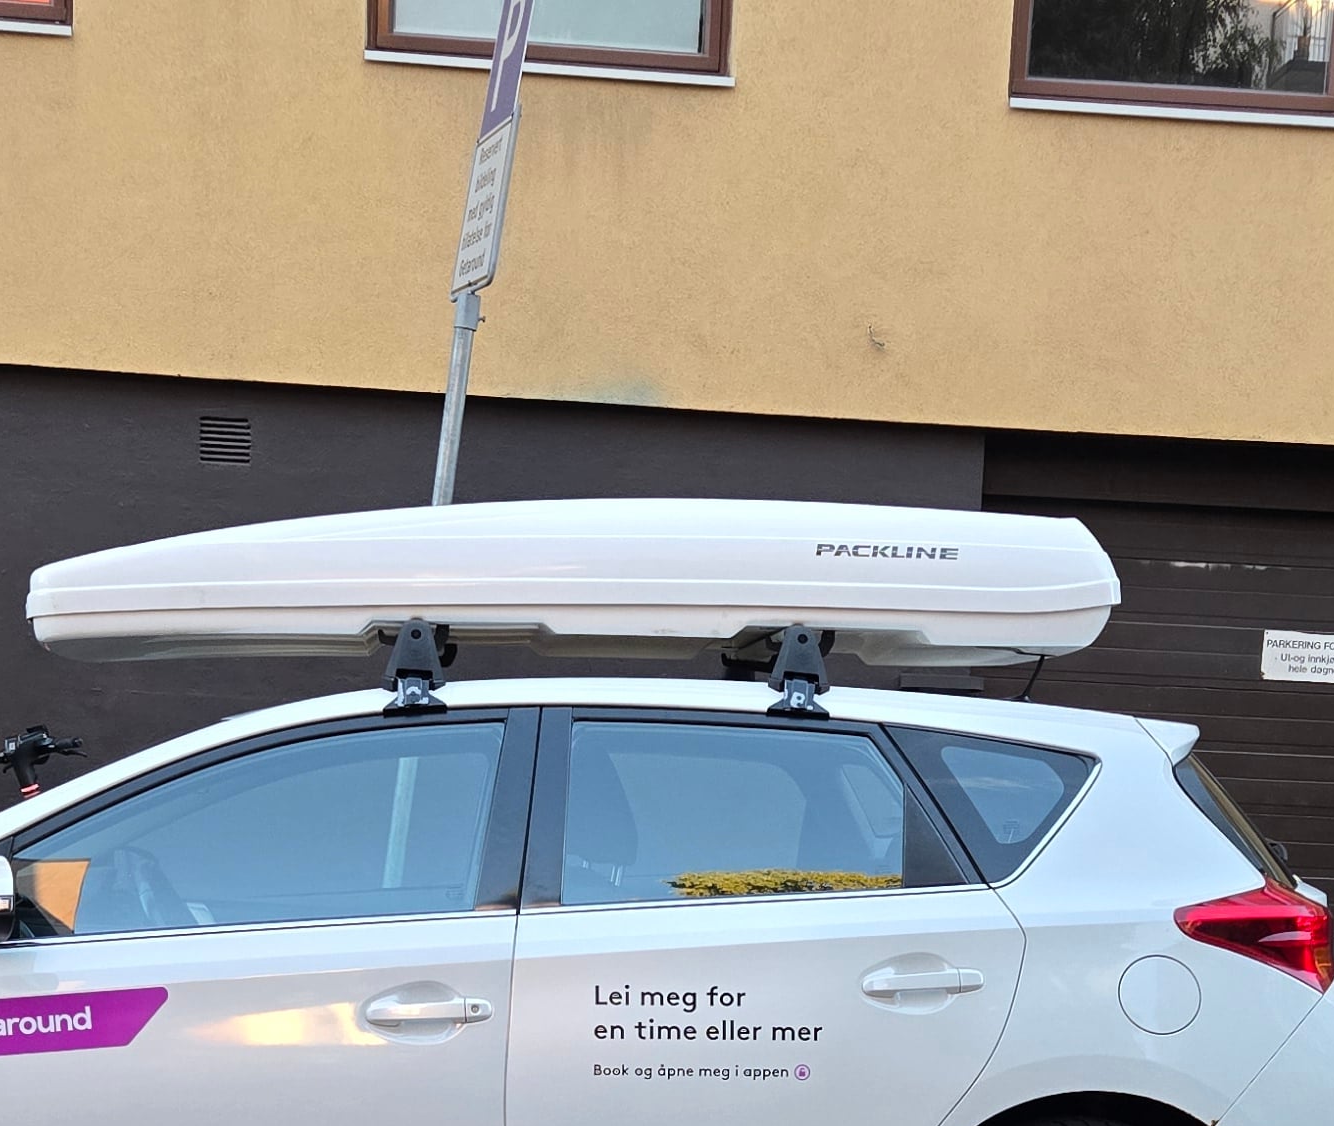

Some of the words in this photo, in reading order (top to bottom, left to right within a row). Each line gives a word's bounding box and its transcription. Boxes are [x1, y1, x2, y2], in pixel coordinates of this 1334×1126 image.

[490, 0, 526, 112] P
[815, 543, 959, 561] PACKLINE
[1267, 639, 1321, 650] PARKERING
[1288, 664, 1307, 673] hele
[593, 983, 630, 1006] Lei
[640, 991, 697, 1013] meg
[706, 986, 746, 1007] for
[593, 1024, 625, 1040] en
[634, 1018, 697, 1040] time
[705, 1020, 762, 1041] eller
[771, 1025, 823, 1042] mer
[593, 1064, 629, 1077] Book
[634, 1066, 653, 1079] og
[657, 1063, 694, 1080] åpne
[698, 1067, 730, 1081] meg
[735, 1064, 740, 1077] i
[743, 1067, 789, 1081] appen
